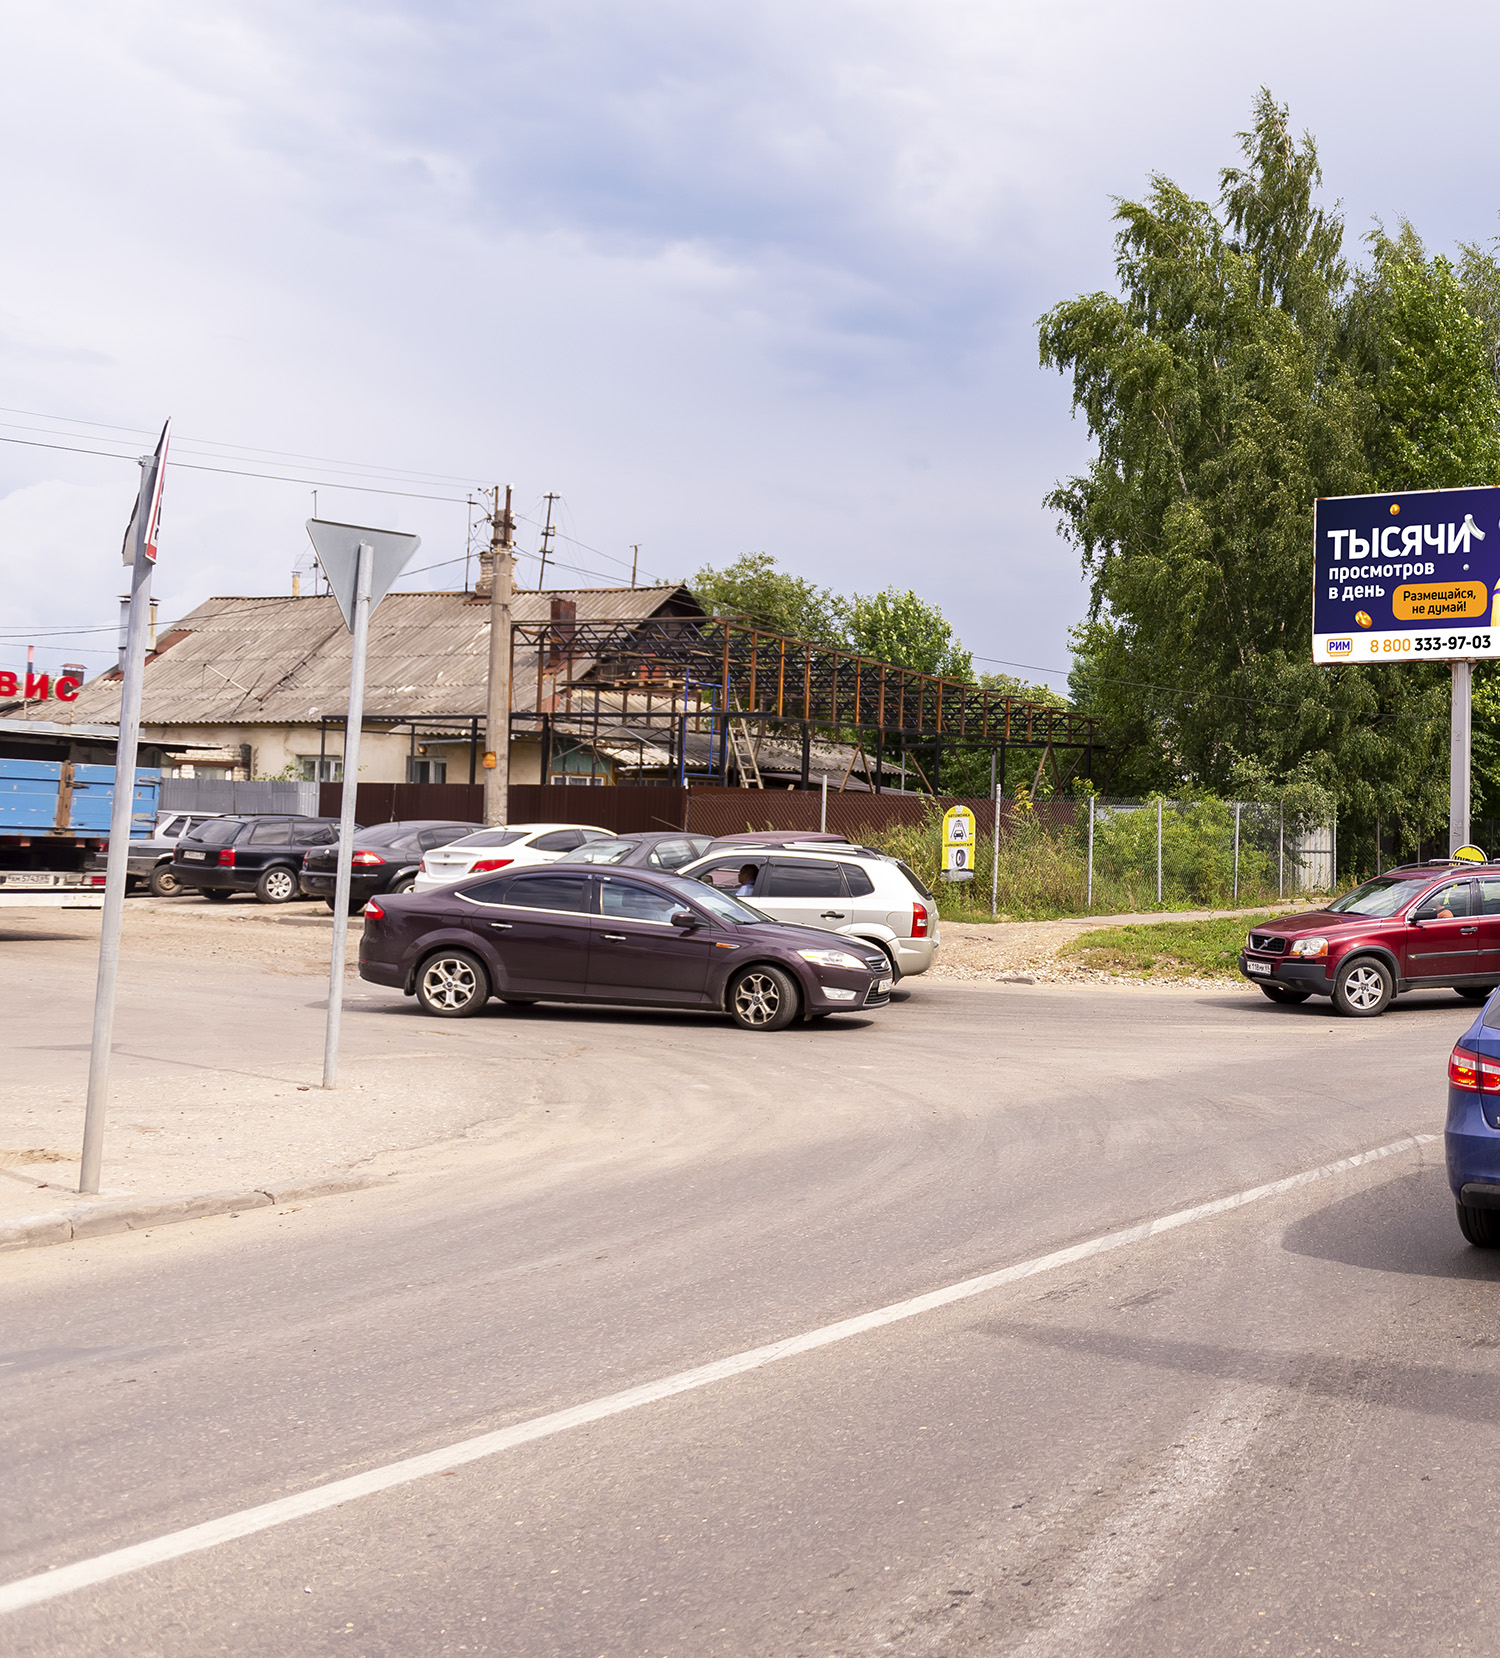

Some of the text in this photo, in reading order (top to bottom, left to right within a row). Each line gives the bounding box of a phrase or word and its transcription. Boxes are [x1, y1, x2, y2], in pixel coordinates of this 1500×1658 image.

[1327, 522, 1472, 560] ТЫСЯЧИ
[1328, 562, 1435, 583] просмотров
[1328, 585, 1385, 601] в день
[1403, 588, 1476, 601] Размещайся,
[1412, 601, 1467, 615] не думай!
[1329, 641, 1351, 651] РИМ
[1370, 635, 1491, 653] 8 800 333-97-03
